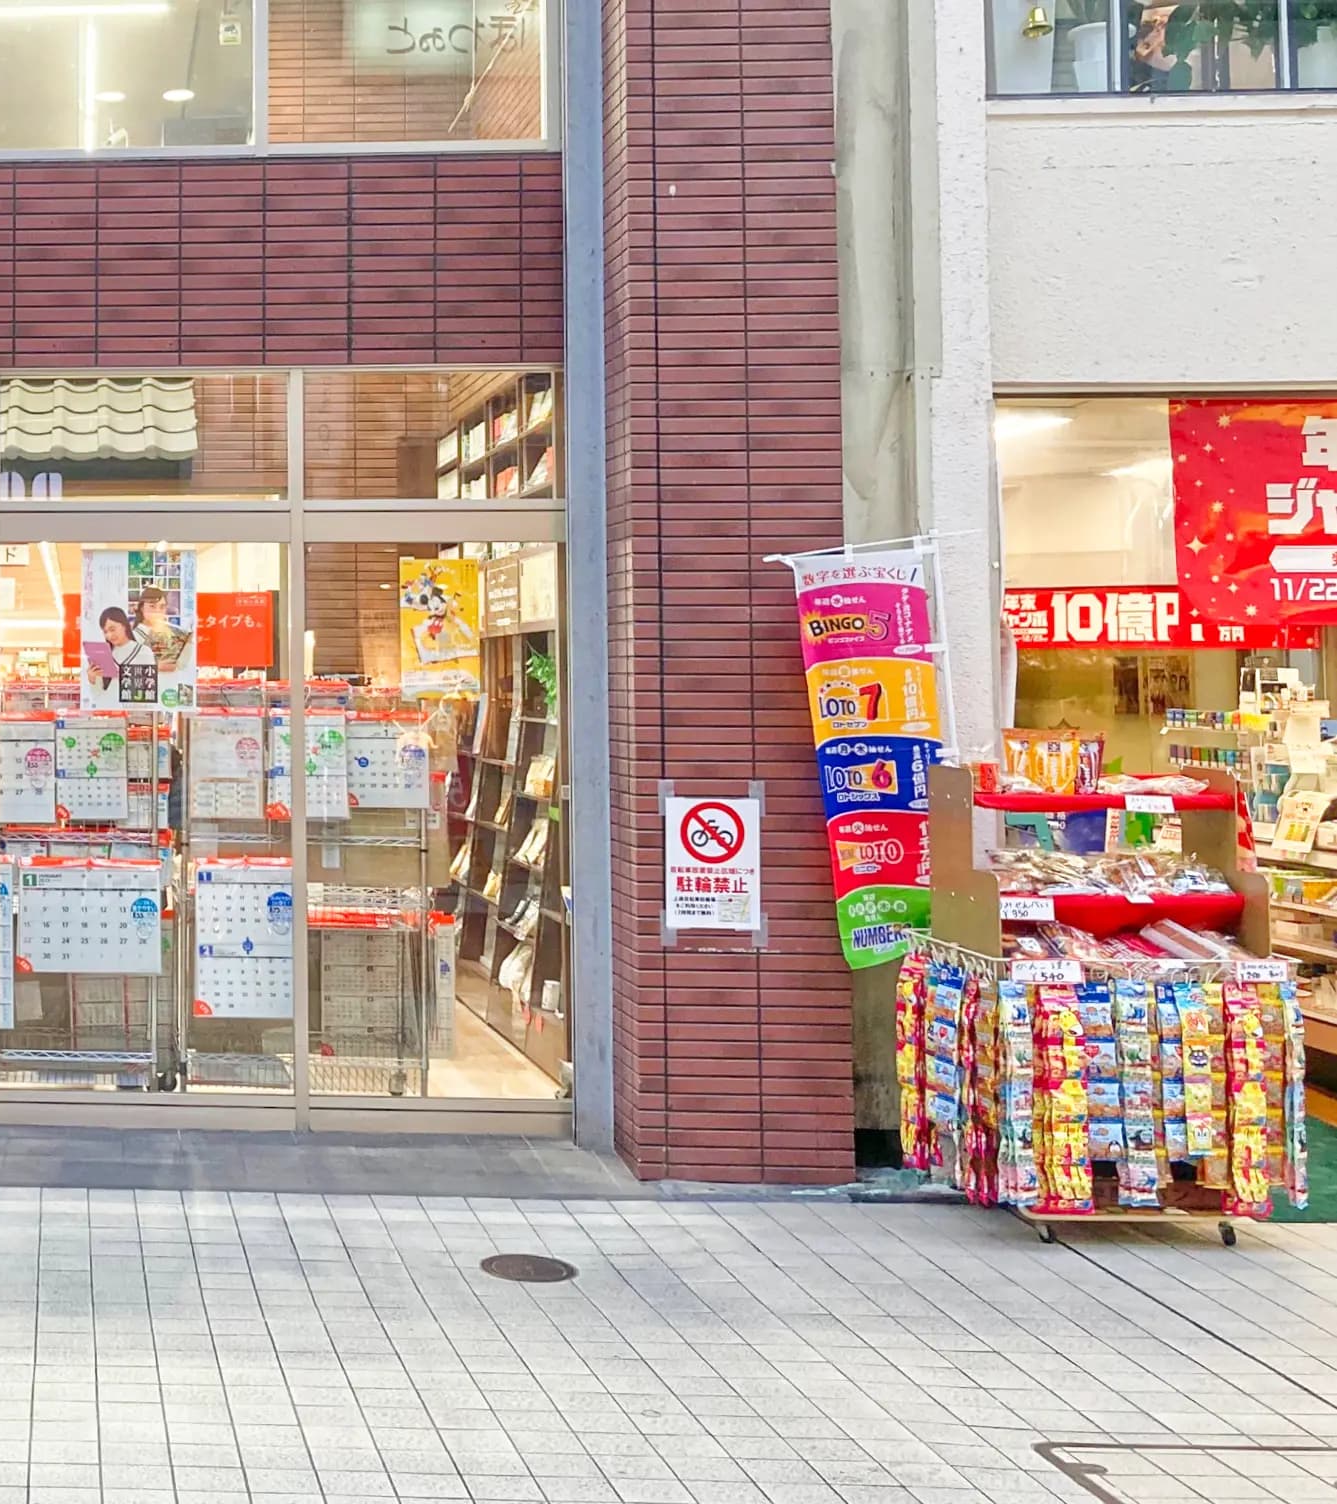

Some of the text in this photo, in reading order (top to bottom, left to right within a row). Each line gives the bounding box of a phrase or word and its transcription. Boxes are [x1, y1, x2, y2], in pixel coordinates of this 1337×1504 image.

[676, 876, 749, 894] 駐輪禁止
[853, 922, 912, 949] NUMBER
